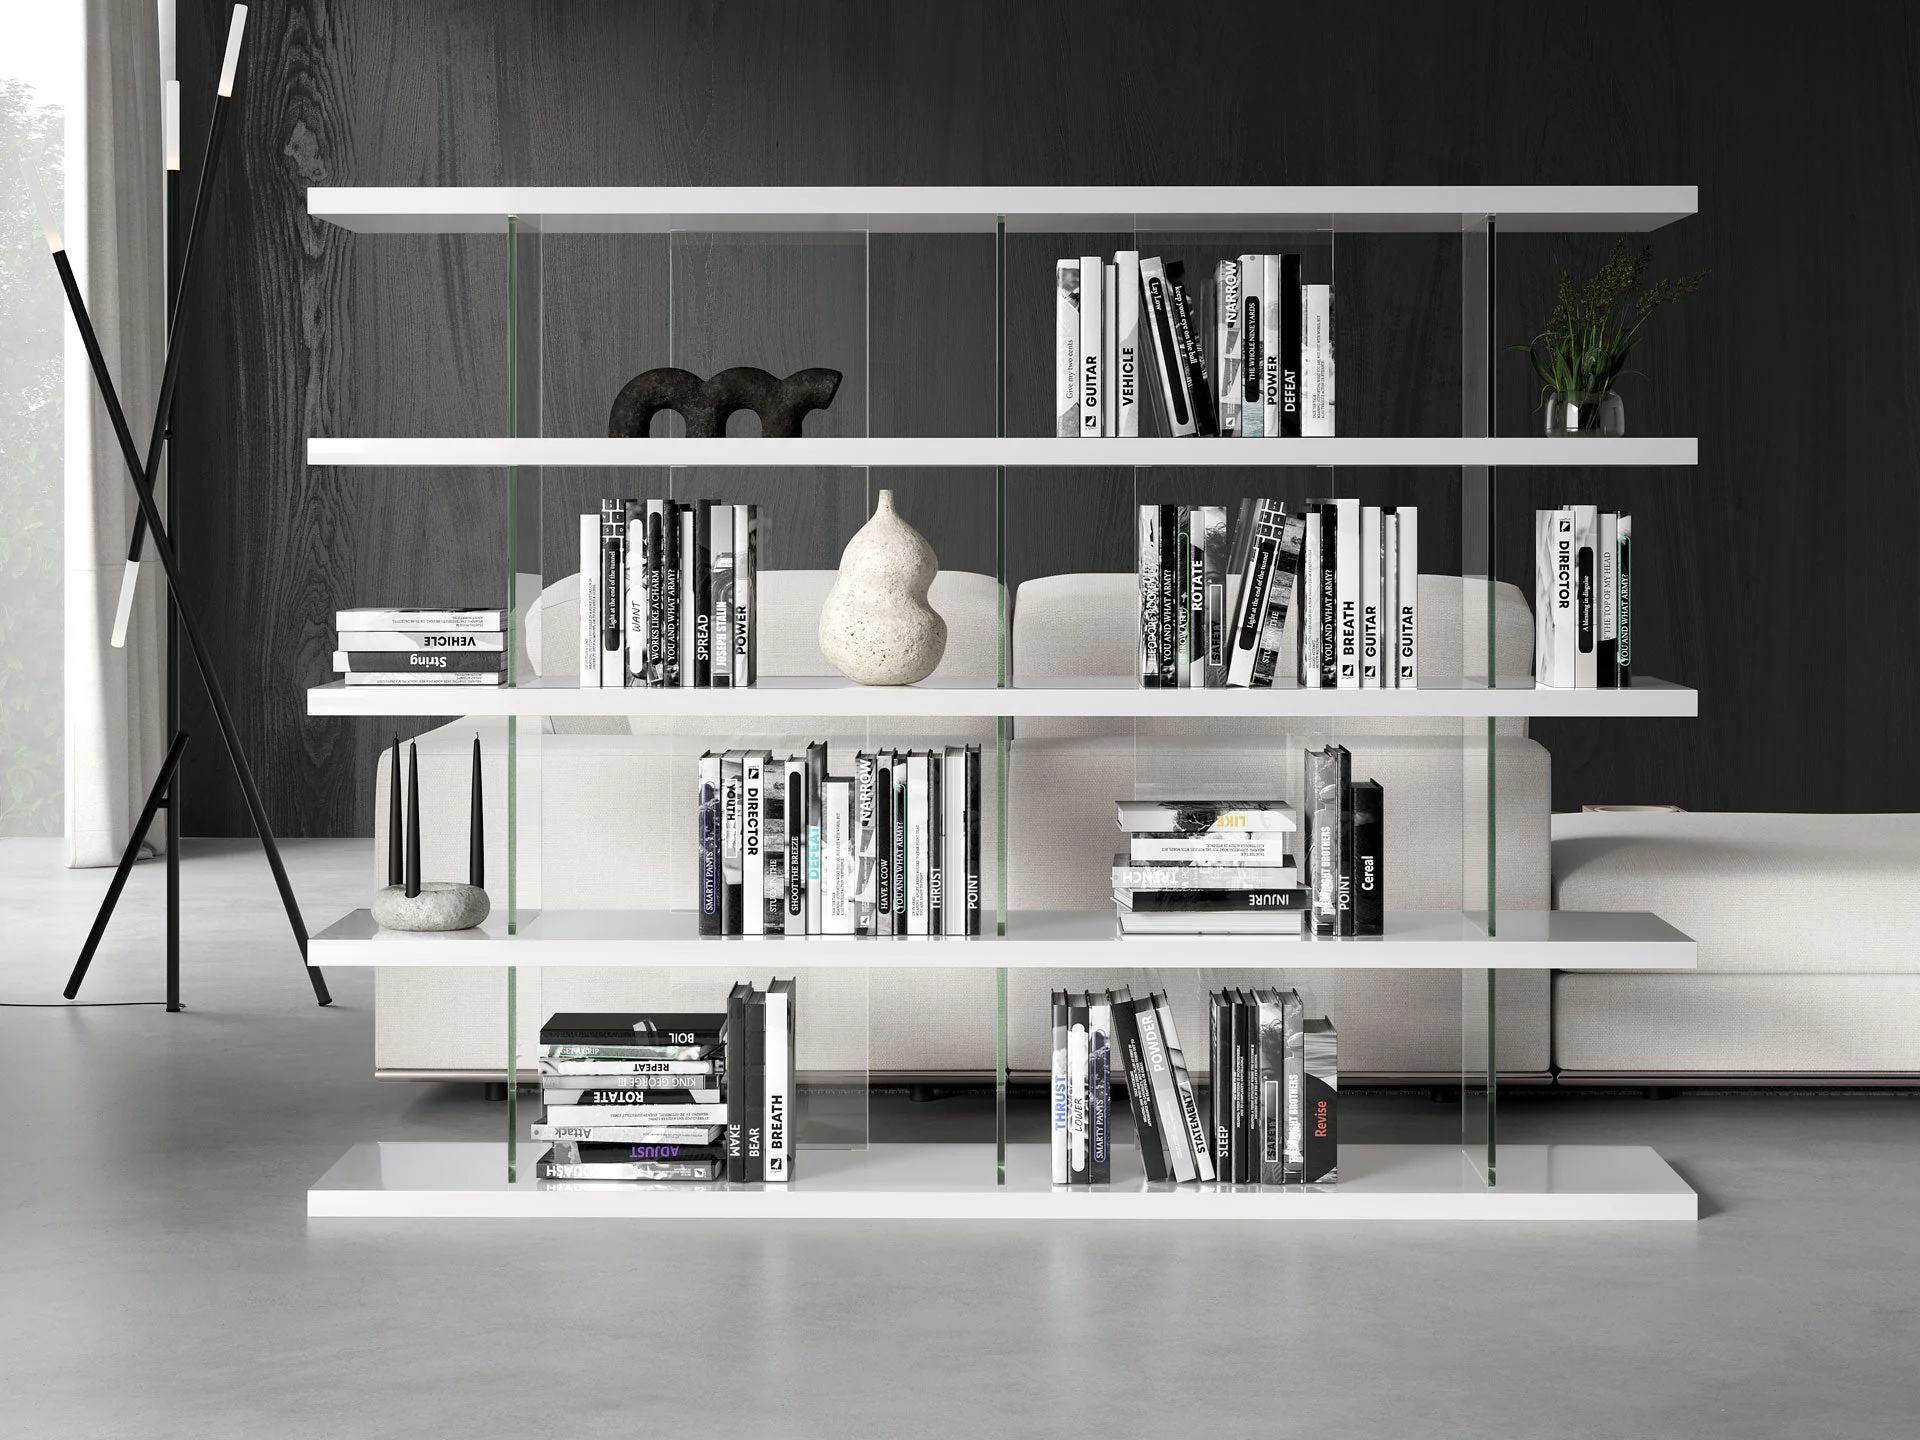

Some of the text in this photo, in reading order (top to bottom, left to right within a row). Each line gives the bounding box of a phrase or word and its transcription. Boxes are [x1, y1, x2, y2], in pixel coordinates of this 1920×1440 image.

[1151, 282, 1162, 311] Lay Low
[1225, 261, 1236, 323] NARROW
[1176, 302, 1186, 317] your
[1184, 331, 1190, 339] on
[1189, 351, 1197, 364] ball
[1068, 372, 1074, 382] my
[1086, 356, 1096, 407] GUITAR
[1123, 348, 1133, 406] VEHICLE
[1267, 356, 1277, 405] POWER
[1285, 370, 1296, 412] DEFEAT
[1257, 570, 1265, 579] the
[1259, 552, 1268, 570] tunnel
[1559, 541, 1570, 608] DIRECTOR
[609, 579, 615, 587] of
[1192, 561, 1203, 611] ROTATE
[1604, 576, 1610, 588] MY
[1604, 589, 1610, 599] OF
[632, 600, 640, 632] WANT
[1247, 614, 1256, 628] Light
[1251, 598, 1259, 607] the
[1269, 611, 1279, 627] THE
[1324, 570, 1333, 661] YOU AND WHAT ARMY?
[424, 636, 476, 646] VEHICLE
[698, 615, 708, 660] SPREAD
[716, 601, 727, 666] JOSEPH STALIN
[736, 606, 746, 655] POWER
[1212, 620, 1220, 661] SAFETY
[1344, 601, 1354, 655] BREATH
[1366, 606, 1376, 657] GUITAR
[1402, 606, 1413, 657] GUITAR
[410, 654, 447, 667] String
[727, 784, 736, 821] YOUTH
[860, 758, 872, 822] NARROW
[747, 788, 758, 855] DIRECTOR
[1216, 815, 1246, 827] LIKE
[808, 826, 820, 880] DEFEAT
[1321, 826, 1330, 867] BROTHERS
[705, 851, 714, 910] SMARTY PANTS
[931, 867, 940, 910] THRUST
[968, 873, 978, 909] POINT
[1122, 871, 1178, 884] TRENCH
[1361, 856, 1374, 890] Cereal
[1249, 894, 1289, 905] INJURE
[1340, 874, 1349, 910] POINT
[668, 1033, 695, 1043] BOIL
[1141, 1014, 1166, 1072] POWDER
[593, 1091, 644, 1102] ROTATE
[630, 1077, 668, 1087] GEORGE
[672, 1077, 696, 1087] KING
[1289, 1074, 1298, 1115] BROTHERS
[1055, 1075, 1066, 1131] THRUST
[1074, 1098, 1083, 1132] LOWER
[1315, 1101, 1328, 1137] Revise
[554, 1127, 591, 1138] Attack
[771, 1095, 782, 1149] BREATH
[1096, 1099, 1104, 1159] SMARTY PANTS
[1182, 1094, 1207, 1154] STATEMENT
[1267, 1117, 1277, 1157] SAFETY
[630, 1146, 679, 1157] ADJUST
[749, 1128, 759, 1156] BEAR
[1218, 1126, 1228, 1157] SLEEP
